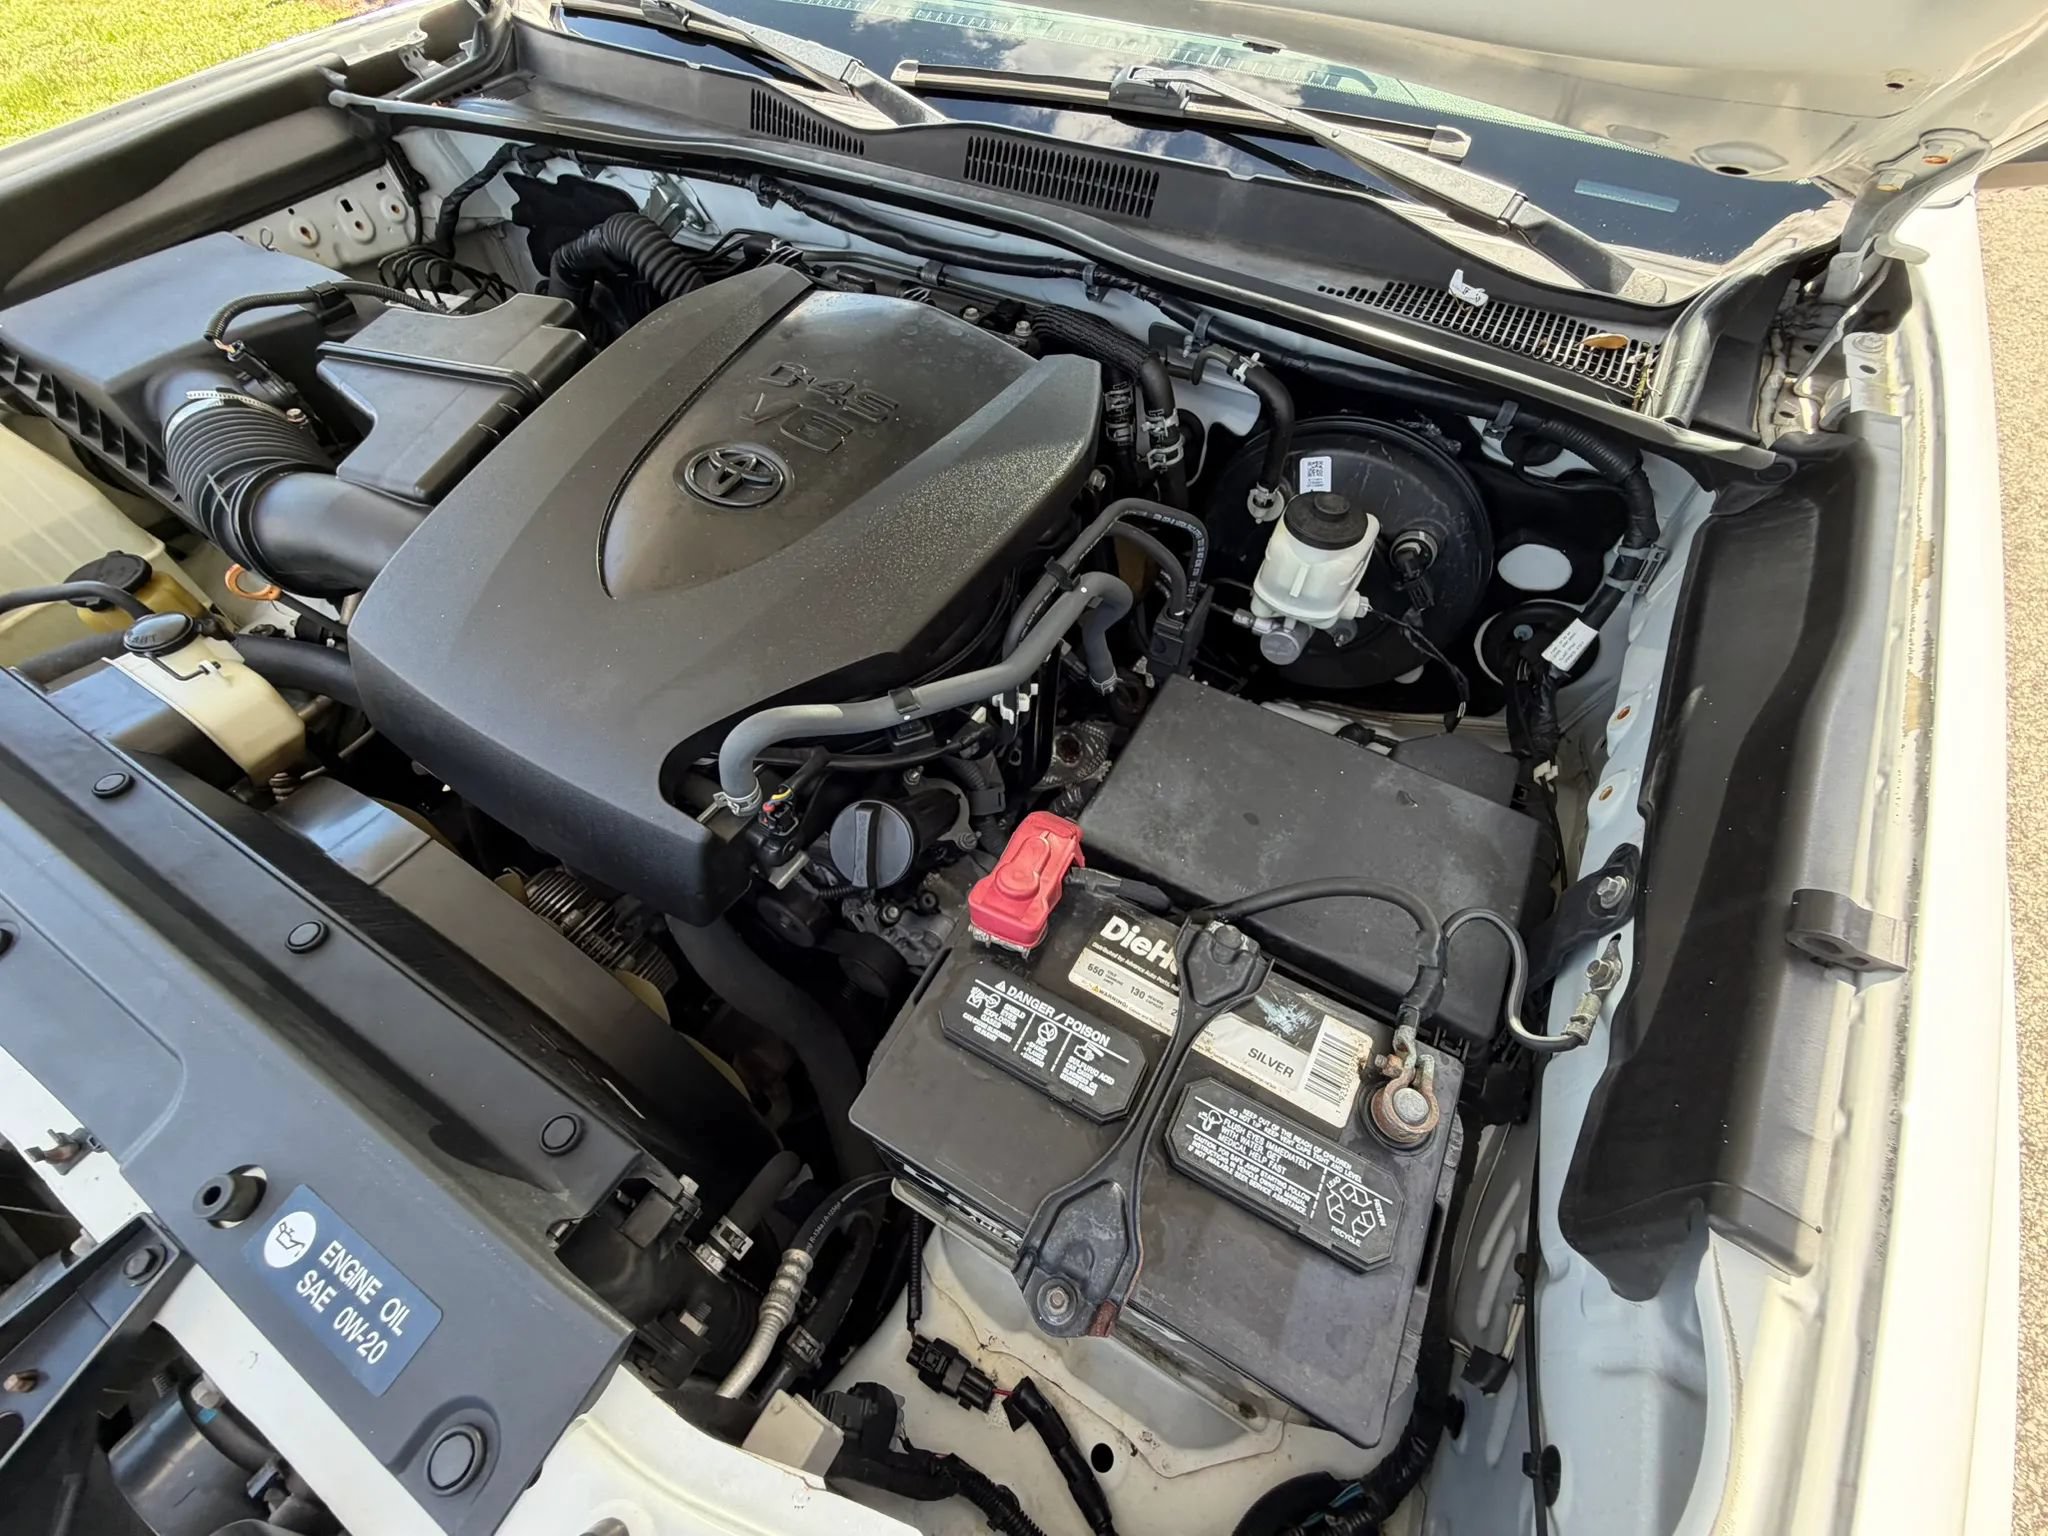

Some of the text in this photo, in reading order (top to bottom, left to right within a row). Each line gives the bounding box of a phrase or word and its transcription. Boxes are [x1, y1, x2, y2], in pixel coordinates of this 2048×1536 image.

[1087, 963, 1104, 976] 650
[1130, 986, 1145, 999] 130
[1144, 970, 1157, 979] Auto
[1006, 985, 1055, 1018] DANGER
[1064, 1016, 1110, 1047] POISON
[1067, 1056, 1115, 1085] SULFURIC ACID
[1248, 1048, 1294, 1078] SILVER
[1191, 1140, 1229, 1164] INSTRUCTIONS
[1194, 1149, 1206, 1159] NOT
[1217, 1133, 1287, 1175] MEDICAL HELP FAST
[1221, 1125, 1239, 1140] WITH
[1266, 1150, 1281, 1163] GET
[1222, 1118, 1312, 1170] FLUSH EYES IMMEDIATELY
[1229, 1108, 1238, 1116] DO
[1238, 1113, 1251, 1123] NOT
[1264, 1126, 1279, 1137] KEEP
[1280, 1135, 1295, 1146] VENT
[1295, 1143, 1311, 1155] CAPS
[1330, 1162, 1344, 1173] AND
[1242, 1108, 1258, 1119] KEEP
[1258, 1117, 1271, 1127] OUT
[1271, 1123, 1280, 1131] OF
[1281, 1128, 1293, 1139] THE
[1293, 1135, 1313, 1150] REACH
[1323, 1151, 1352, 1170] CHILDREN
[1217, 1147, 1230, 1157] FOR
[1260, 1170, 1287, 1189] STARTING
[1287, 1185, 1311, 1202] FOLLOW
[1326, 1177, 1341, 1189] LEAD
[1374, 1199, 1387, 1226] RETURN
[1331, 1225, 1362, 1247] RECYCLE
[319, 1240, 410, 1336] ENGINE OIL
[295, 1270, 388, 1365] SAE 0W-20
